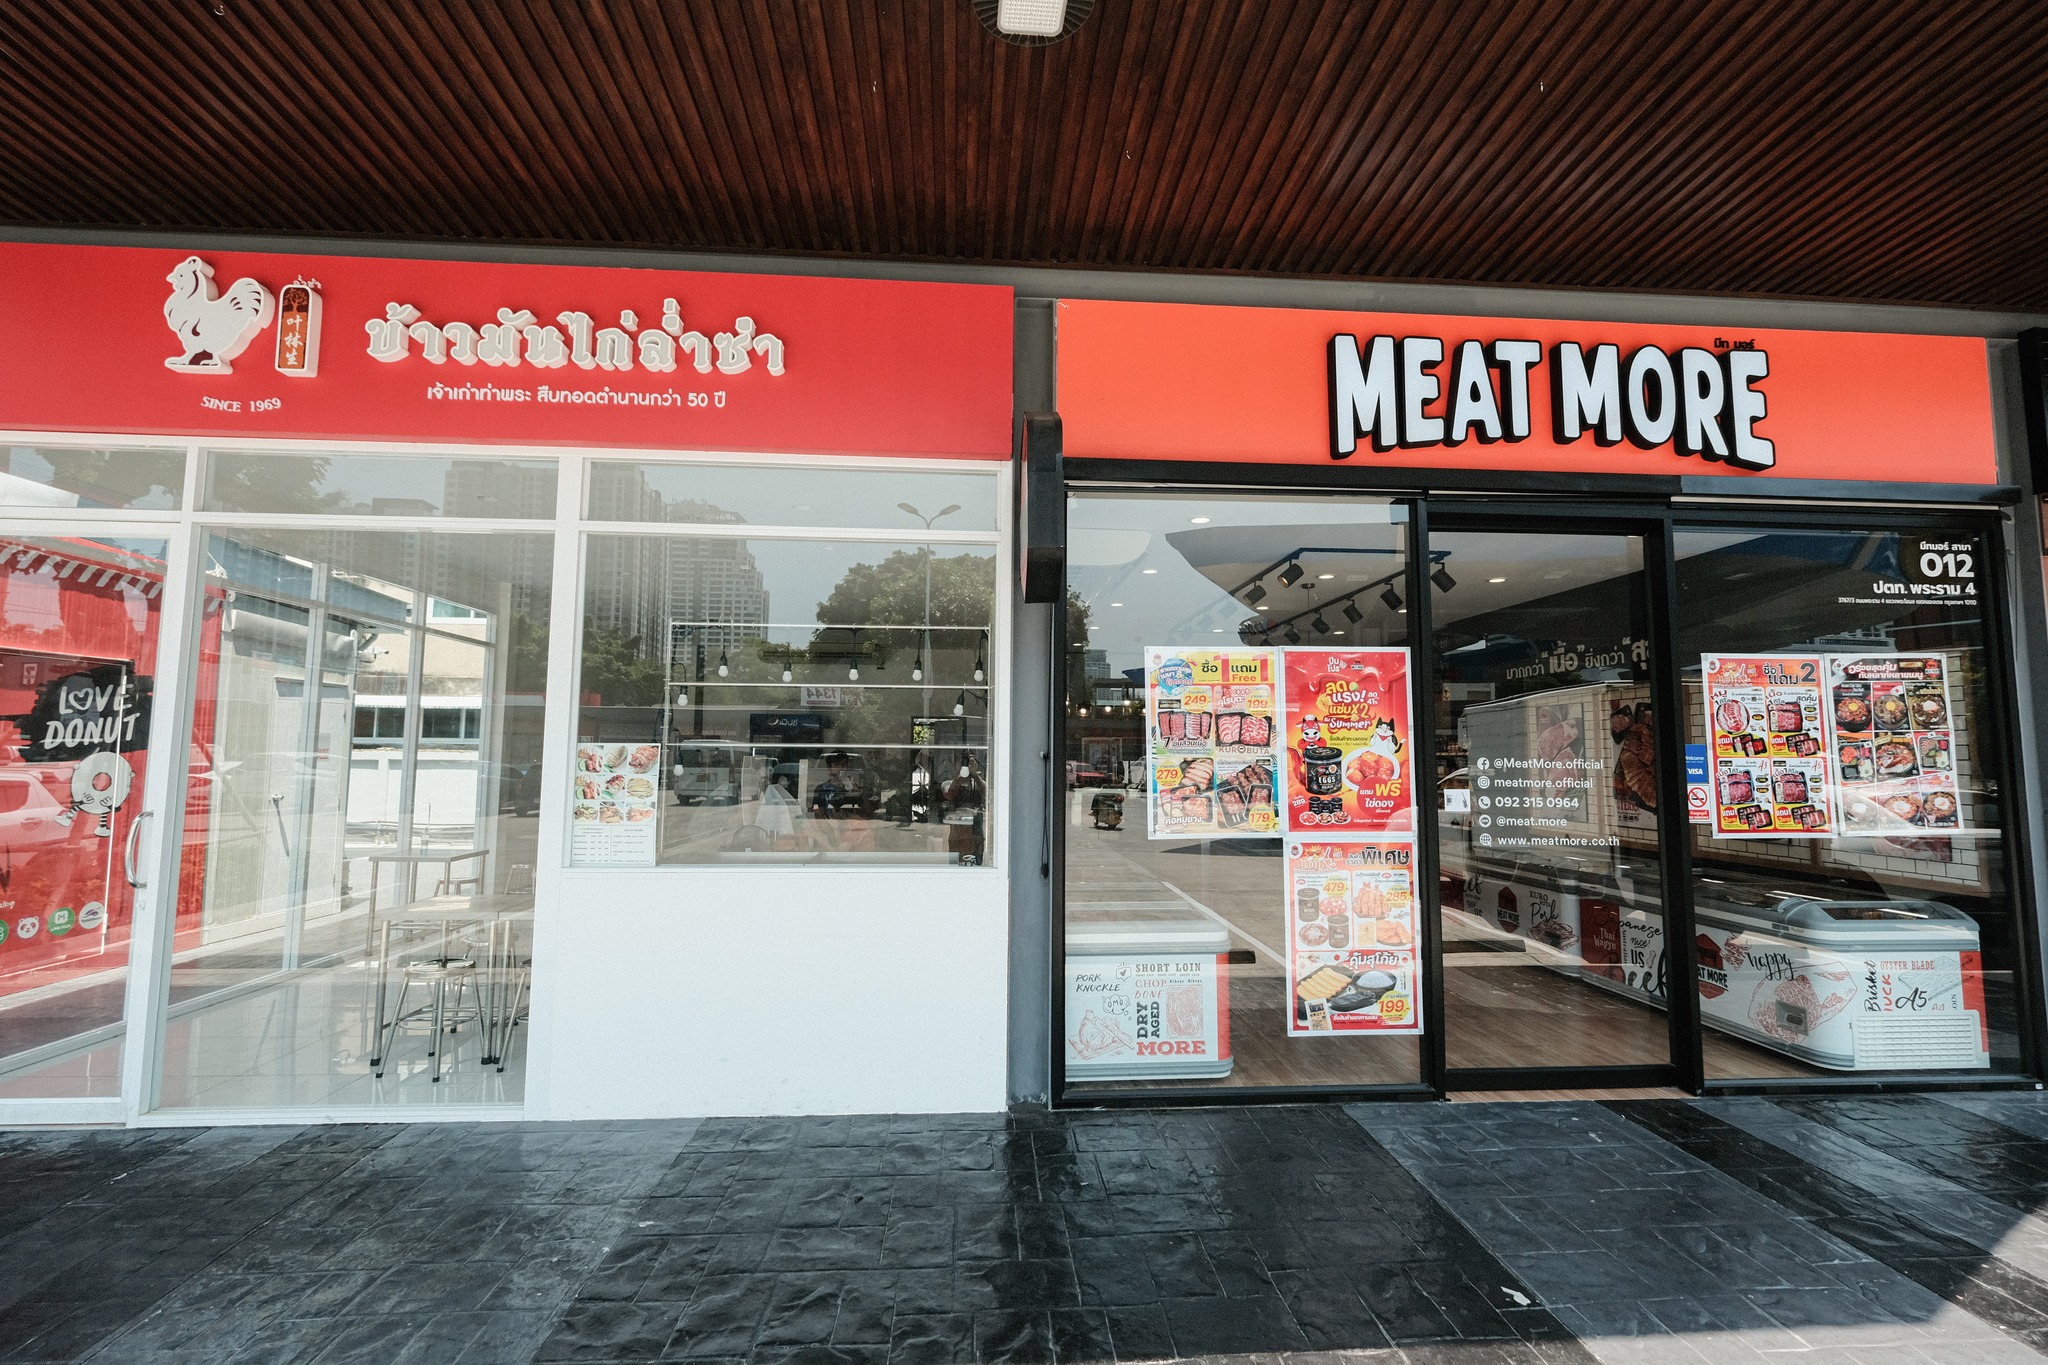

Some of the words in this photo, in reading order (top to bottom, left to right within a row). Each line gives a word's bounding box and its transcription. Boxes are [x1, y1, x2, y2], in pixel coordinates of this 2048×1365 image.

[285, 315, 303, 366] 叶林生
[365, 298, 785, 376] ข้าวมันไก่ล่ำซำ
[428, 382, 532, 401] เจ้าเก่าท่าพระ
[538, 386, 681, 406] สืบทอดตำนานกว่า
[687, 393, 709, 407] 50
[714, 391, 726, 408] ปี
[1327, 333, 1542, 460] MEAT
[1549, 341, 1775, 472] MORE
[201, 396, 241, 412] SINCE
[249, 397, 281, 412] 1969
[1951, 543, 1971, 551] สาขา
[1920, 553, 1975, 577] 012
[1873, 581, 1908, 594] ปตท.
[1910, 583, 1960, 595] พระราม
[1965, 583, 1976, 595] 4
[1201, 659, 1218, 673] ซื้อ
[1213, 654, 1230, 682] 1
[1231, 664, 1257, 673] แถม
[1252, 654, 1269, 682] 1
[1506, 659, 1545, 680] มากกว่า
[1763, 662, 1777, 675] ซื้อ
[1778, 663, 1785, 674] 1
[1768, 675, 1799, 685] แถม
[1800, 662, 1817, 683] 2
[1232, 674, 1257, 682] Free
[1325, 680, 1348, 694] ลด
[1332, 690, 1366, 703] แรง!
[1330, 717, 1371, 730] Summer
[43, 713, 141, 750] DONUT
[1219, 745, 1270, 754] KUROBUTA
[1494, 757, 1603, 770] @MeatMore.official
[1375, 779, 1403, 797] ฟรี
[1495, 777, 1593, 789] meatmore.official
[1365, 797, 1395, 808] ไข่ดอง
[1495, 797, 1520, 807] 092
[1523, 797, 1543, 807] 315
[1546, 797, 1579, 808] 0964
[1496, 816, 1567, 827] @meat.more
[1498, 836, 1620, 847] www.meatmore.co.th
[1362, 846, 1410, 865] พิเศษ
[1530, 890, 1549, 902] KURO
[1530, 900, 1559, 925] Pork
[1600, 928, 1616, 941] Thai
[1593, 935, 1617, 951] Wagyu
[1630, 949, 1645, 969] US
[1880, 961, 1908, 970] OYSTER
[1911, 961, 1935, 970] BLADE
[1135, 963, 1170, 972] SHORT
[1175, 963, 1201, 972] LOIN
[1747, 953, 1795, 982] happy
[1076, 973, 1102, 982] PORK
[1135, 979, 1167, 987] CHOP
[1707, 970, 1729, 988] MORE
[1076, 984, 1121, 992] KNUCKLE
[1864, 959, 1881, 1012] Brisket
[1137, 1001, 1148, 1039] DRY
[1151, 1001, 1160, 1038] AGED
[1136, 1040, 1206, 1056] MORE
